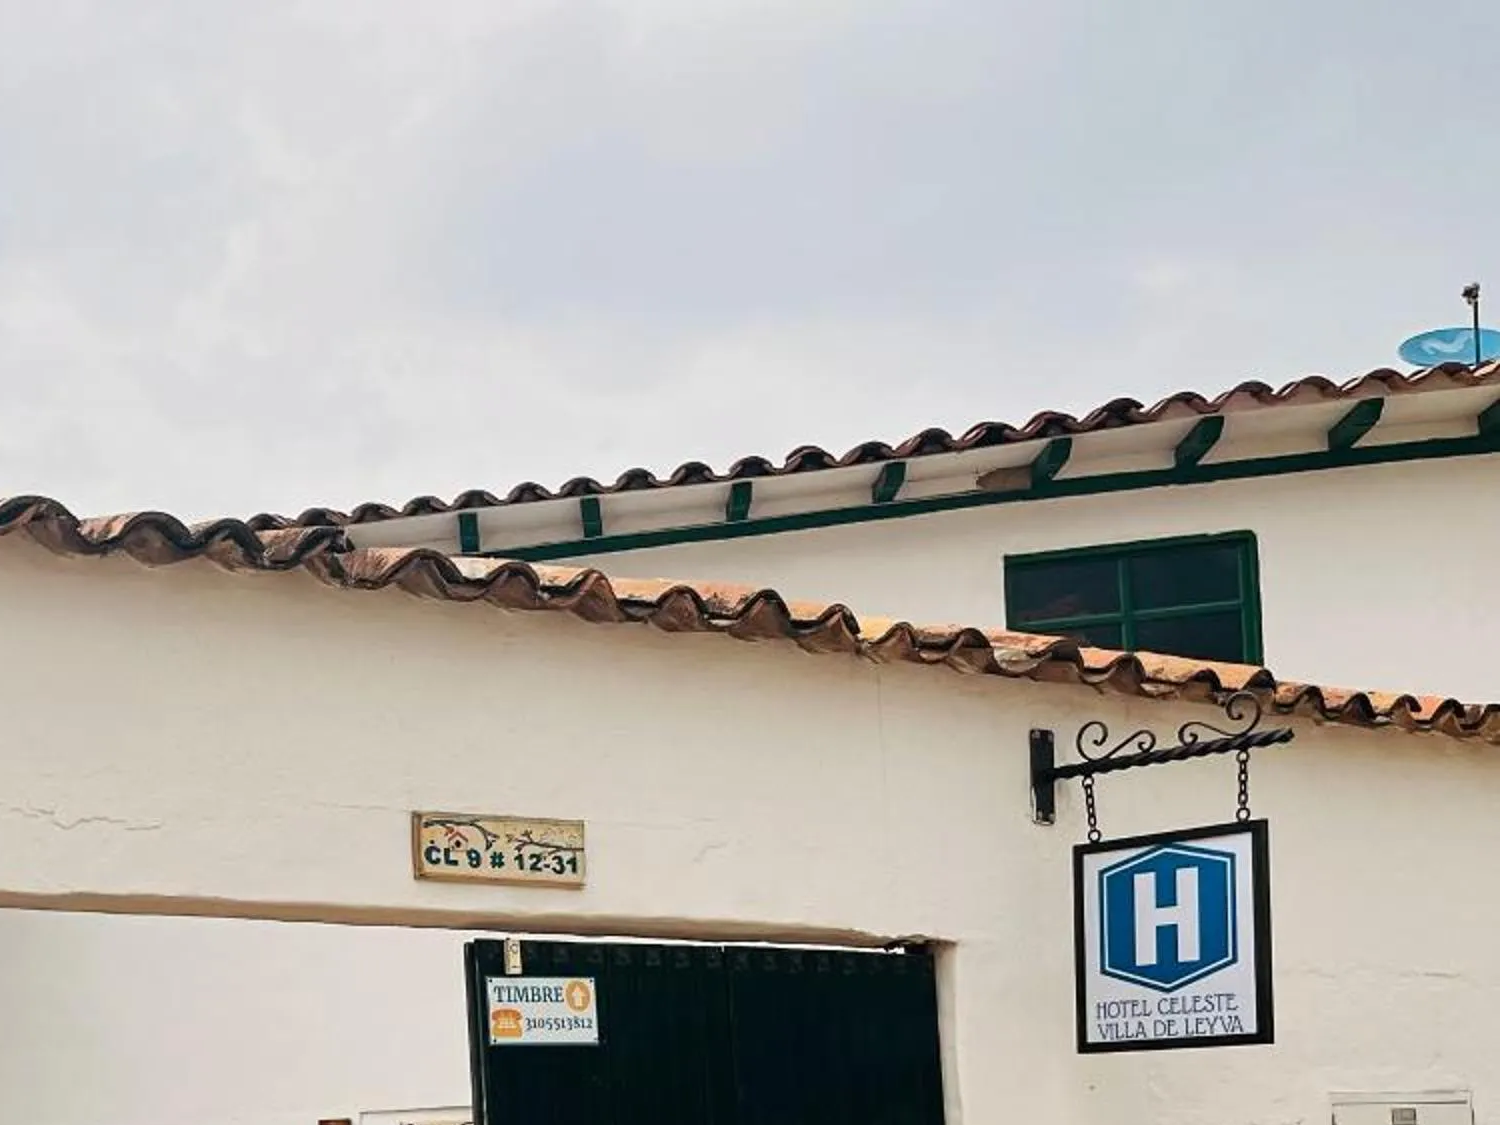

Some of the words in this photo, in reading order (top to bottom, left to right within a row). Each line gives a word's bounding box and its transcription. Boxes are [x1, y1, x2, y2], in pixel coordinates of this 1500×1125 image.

[424, 846, 458, 866] CL
[467, 848, 481, 868] 9
[490, 851, 505, 869] #
[514, 853, 577, 874] 12-31
[1134, 866, 1199, 966] H
[494, 986, 564, 1003] TIMBRE
[1097, 1000, 1152, 1019] HOTEL
[1157, 993, 1238, 1015] CELESTE
[1097, 1021, 1147, 1040] VILLA
[1153, 1019, 1179, 1036] DE
[1184, 1015, 1244, 1036] LEYVA
